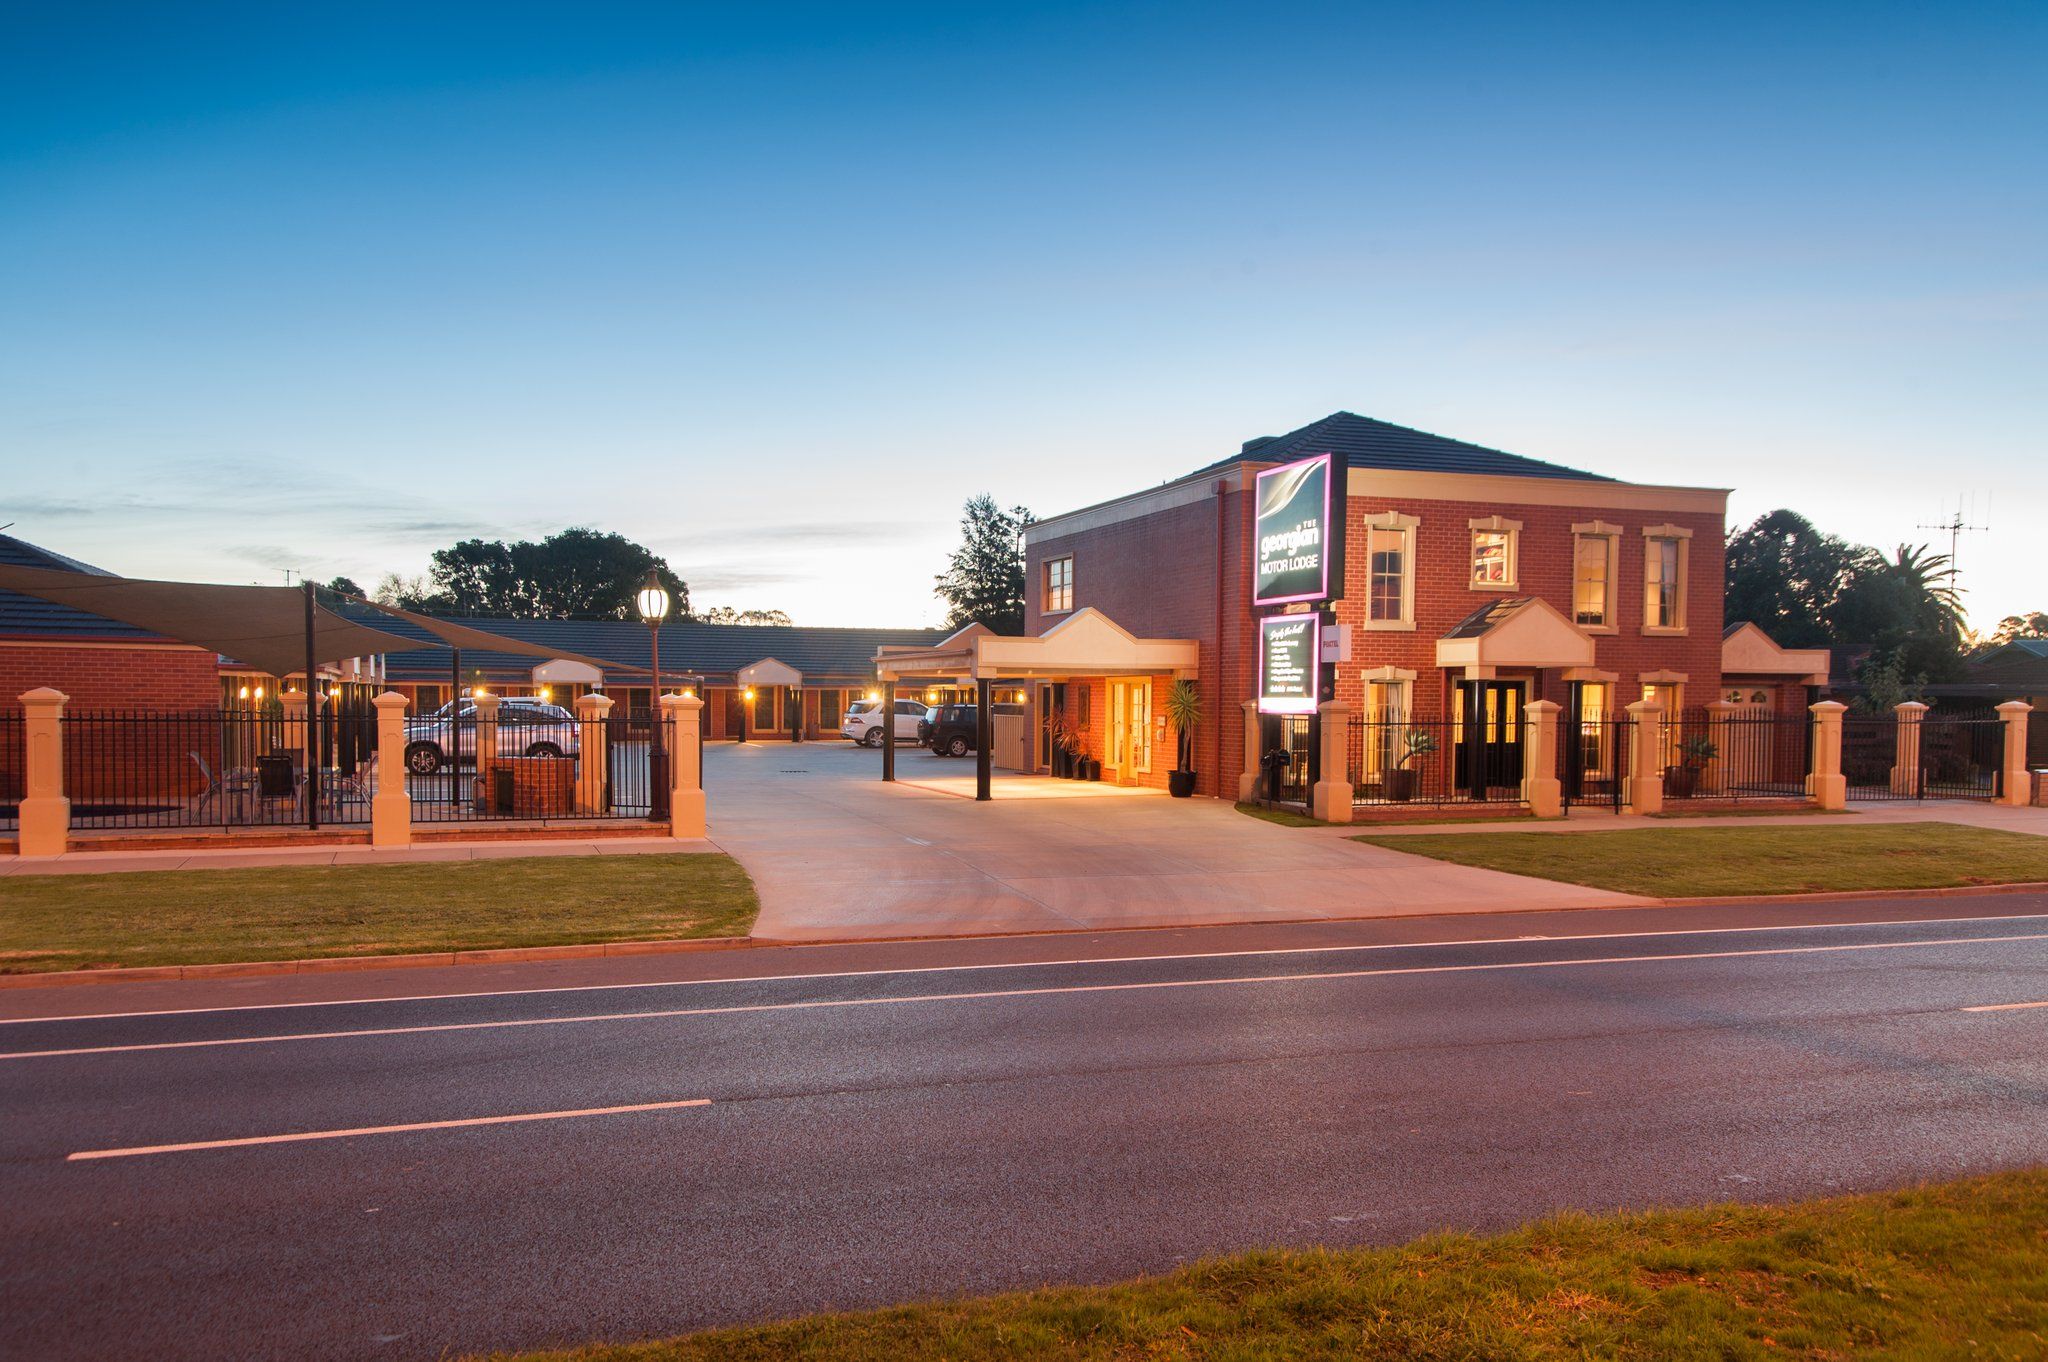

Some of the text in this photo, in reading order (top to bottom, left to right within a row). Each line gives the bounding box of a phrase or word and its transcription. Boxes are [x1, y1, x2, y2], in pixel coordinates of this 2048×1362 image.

[1303, 519, 1317, 529] THE
[1261, 524, 1319, 560] georgian
[1261, 554, 1319, 575] MOTOR LODGE
